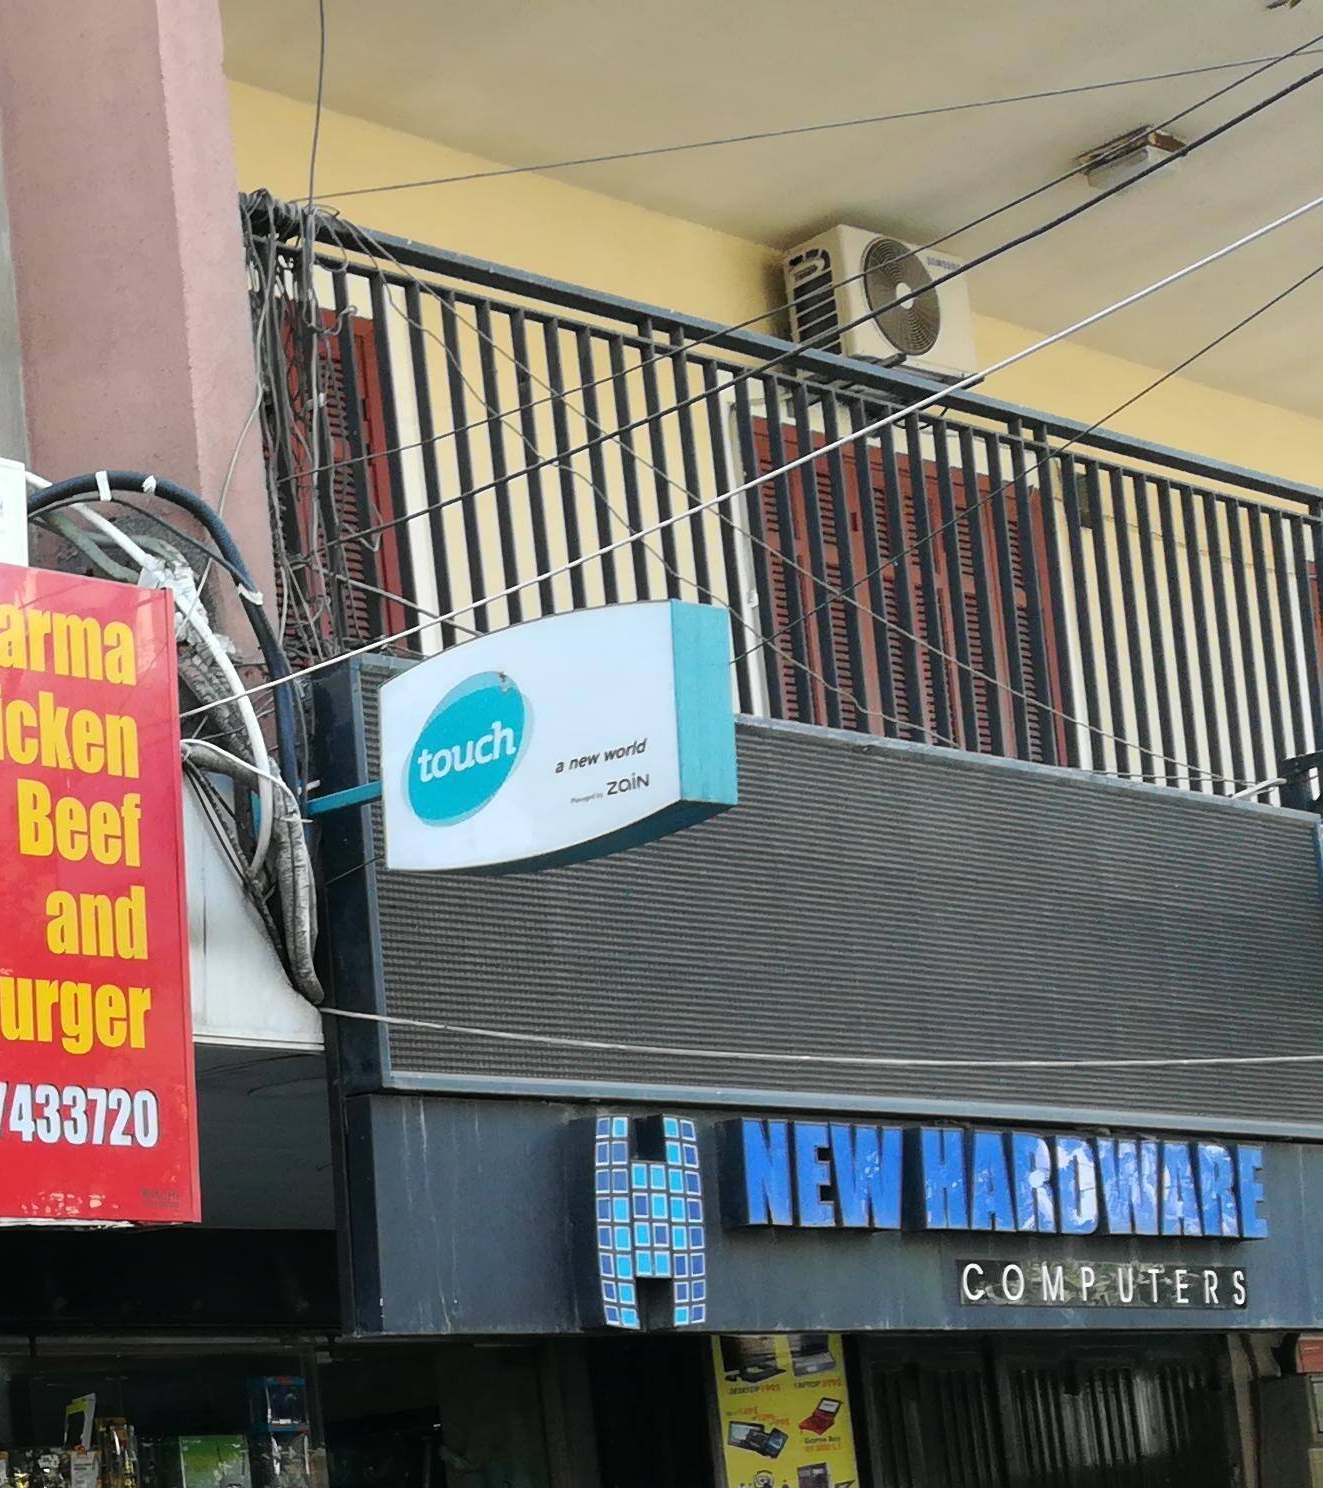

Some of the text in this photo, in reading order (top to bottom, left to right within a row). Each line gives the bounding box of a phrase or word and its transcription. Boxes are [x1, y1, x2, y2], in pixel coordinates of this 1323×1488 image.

[417, 720, 517, 784] touch
[554, 737, 647, 774] a new world
[16, 778, 143, 868] Beef
[45, 885, 149, 961] and
[740, 1116, 1269, 1240] NEW HARDWARE
[960, 1262, 1248, 1306] COMPUTERS
